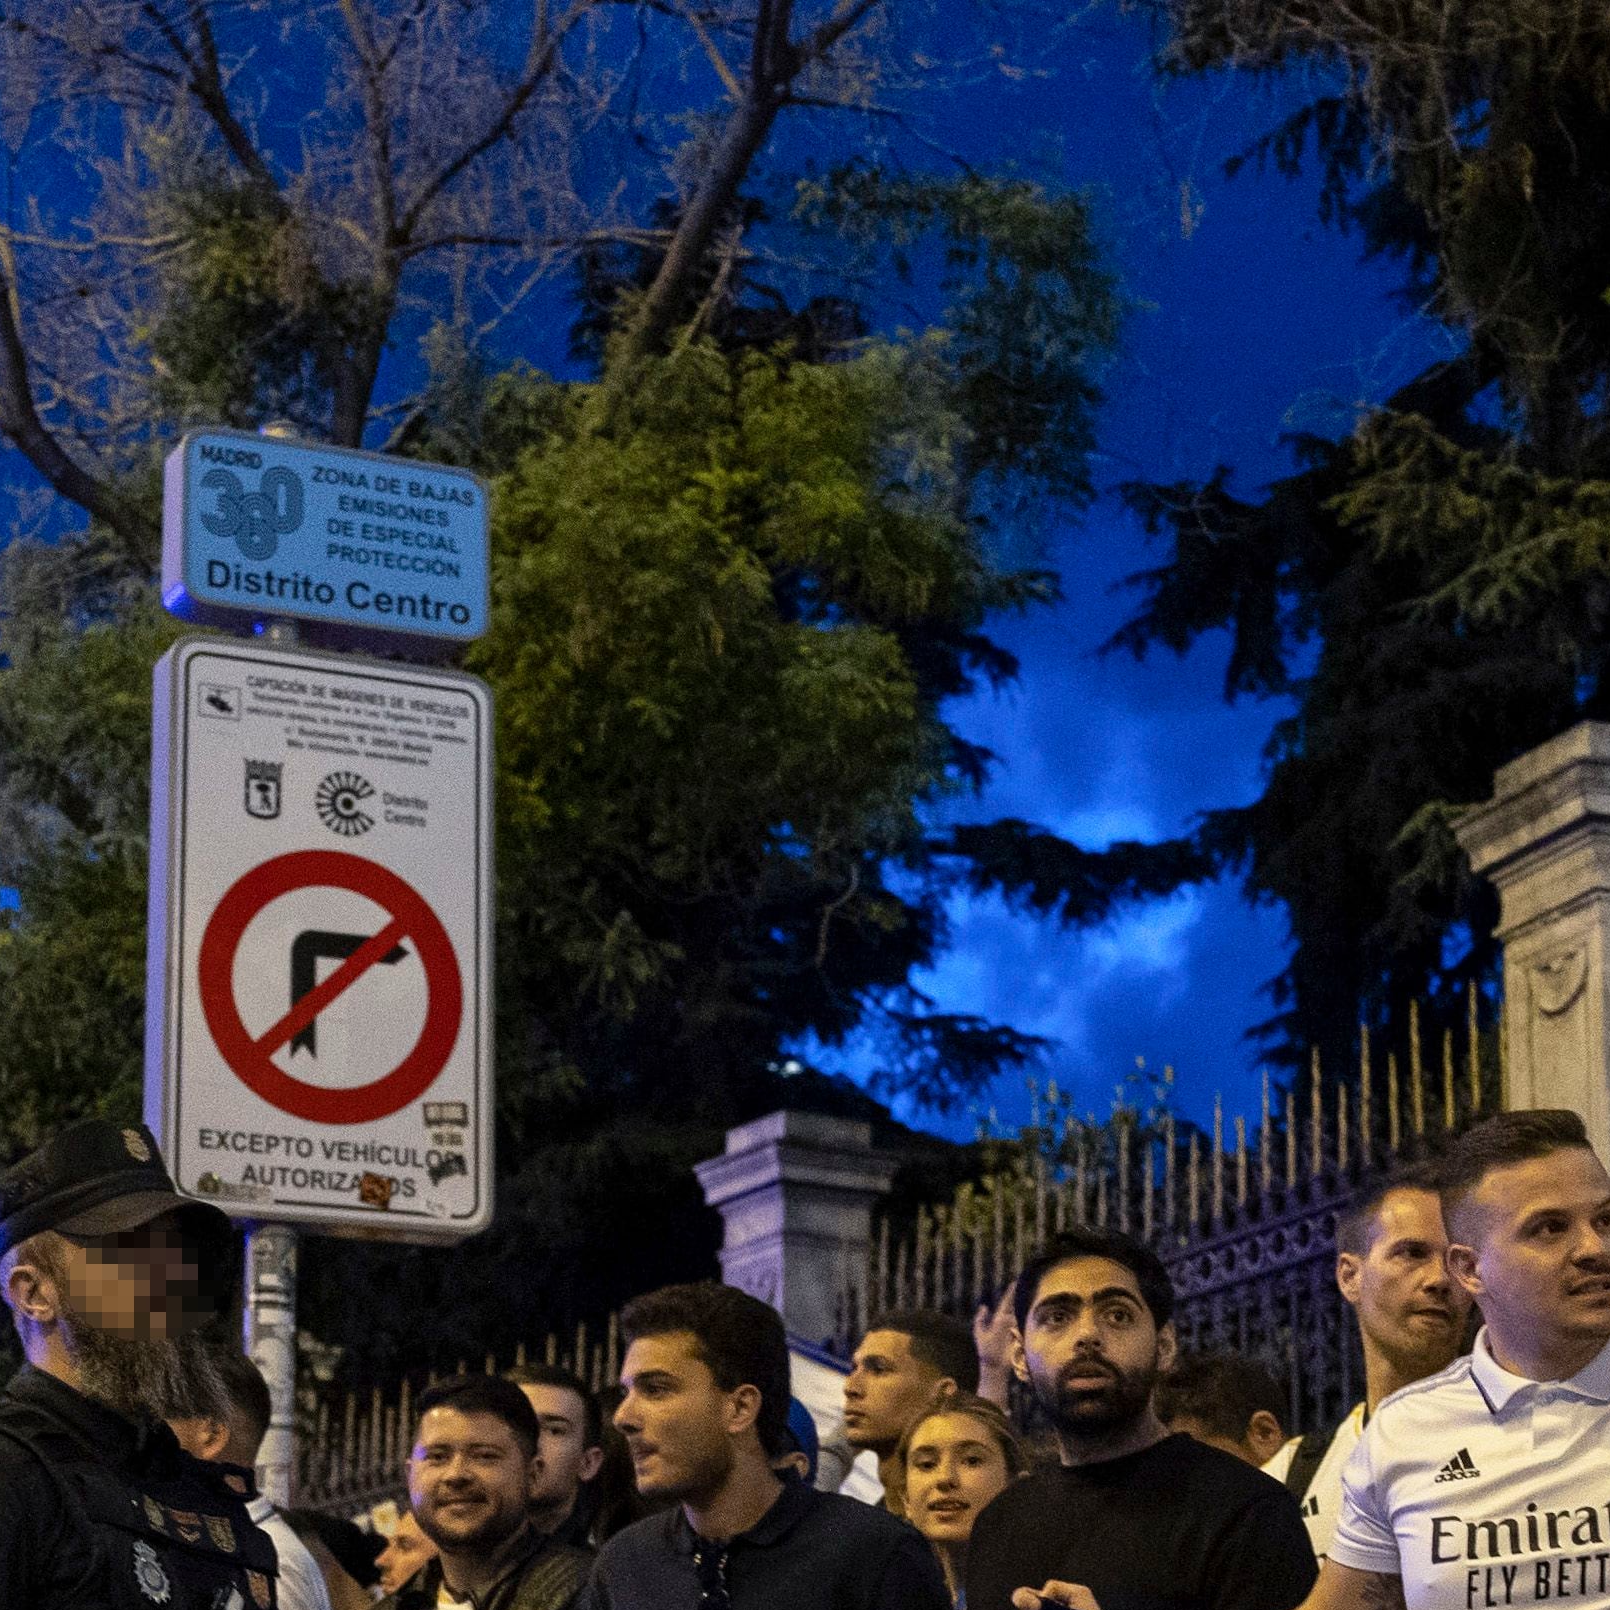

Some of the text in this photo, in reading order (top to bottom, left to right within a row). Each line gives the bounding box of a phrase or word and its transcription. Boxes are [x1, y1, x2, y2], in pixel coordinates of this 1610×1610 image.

[200, 445, 263, 470] MADRID
[312, 466, 474, 507] ZONA DE BAJAS
[338, 494, 450, 527] EMISIONES
[326, 518, 461, 554] DE ESPECIAL
[206, 559, 471, 625] Distrito Centro
[199, 1128, 313, 1160] EXCEPTO
[241, 1164, 417, 1199] AUTORIZAOS
[1467, 1565, 1518, 1610] FLY
